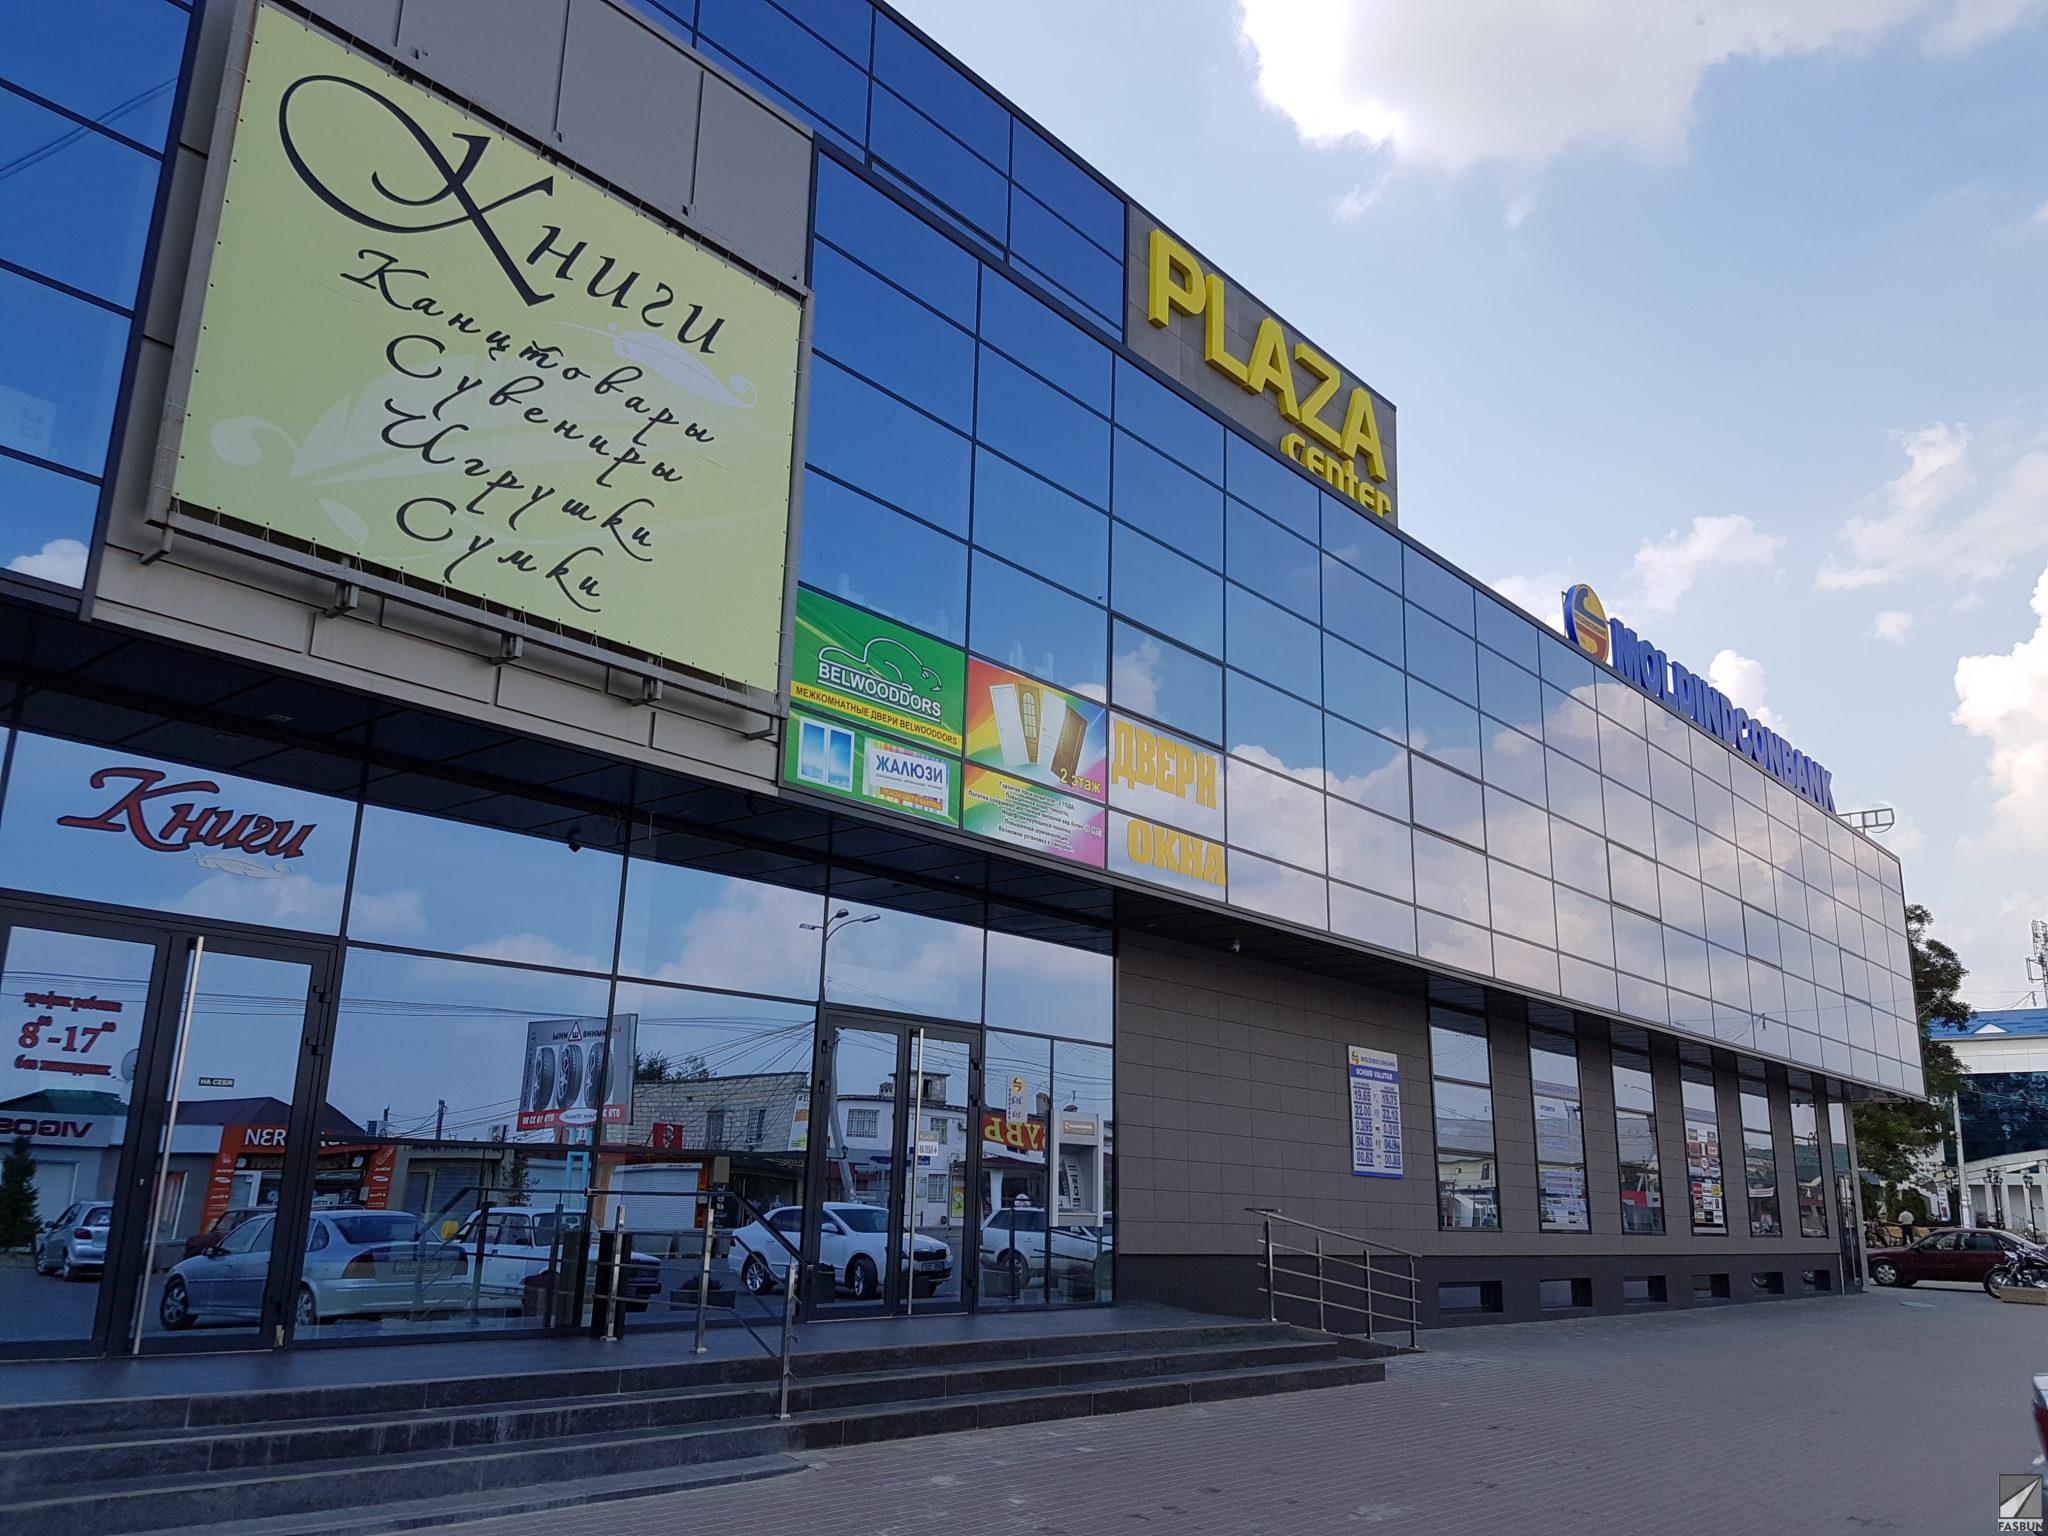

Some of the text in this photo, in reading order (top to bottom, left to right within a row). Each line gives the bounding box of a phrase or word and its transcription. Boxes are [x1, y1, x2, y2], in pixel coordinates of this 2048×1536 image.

[278, 74, 726, 355] Книги
[340, 248, 714, 445] Канцтовары
[1148, 228, 1387, 484] PLAZA
[385, 334, 682, 487] Сувениры
[381, 397, 653, 561] Игрушки
[394, 497, 601, 612] Сумки
[796, 685, 869, 717] МЕЖКОМНАТНЫЕ
[871, 710, 898, 726] ДВЕРИ
[818, 662, 942, 717] BELWOODDORS
[1610, 617, 1837, 815] MOLDINDCONBANK
[876, 754, 943, 784] ЖАЛЮЗИ
[1060, 768, 1070, 785] 2
[1112, 719, 1217, 810] ДВЕРИ
[57, 767, 318, 859] Книги
[1127, 819, 1227, 887] ОКНА
[200, 1078, 233, 1087] НА СЕБЯ
